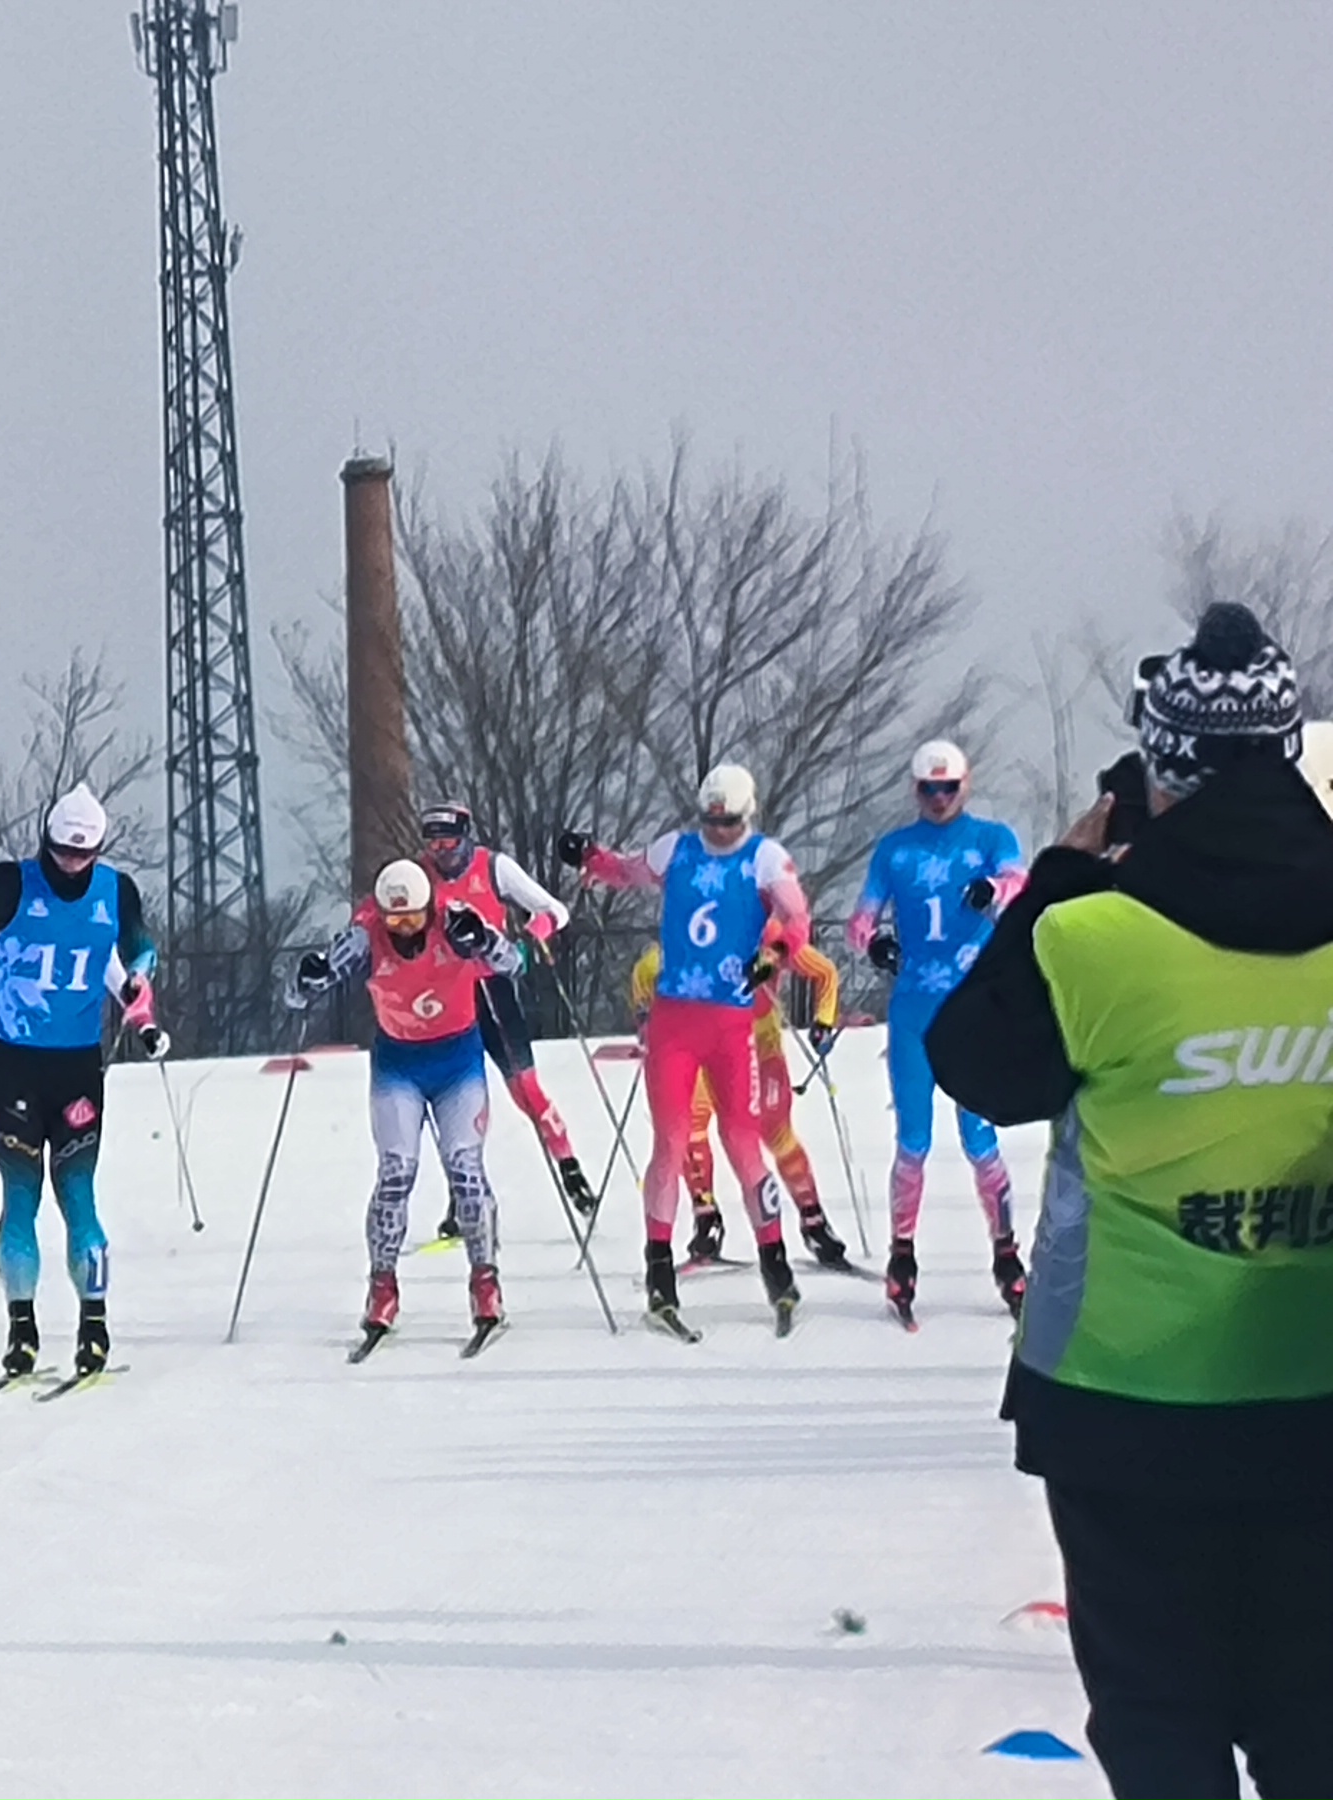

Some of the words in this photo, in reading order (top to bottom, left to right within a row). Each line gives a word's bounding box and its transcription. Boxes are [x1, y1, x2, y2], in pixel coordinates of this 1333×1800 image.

[688, 899, 719, 948] 6
[924, 894, 948, 941] 1
[38, 943, 92, 991] 11
[412, 989, 443, 1019] 6
